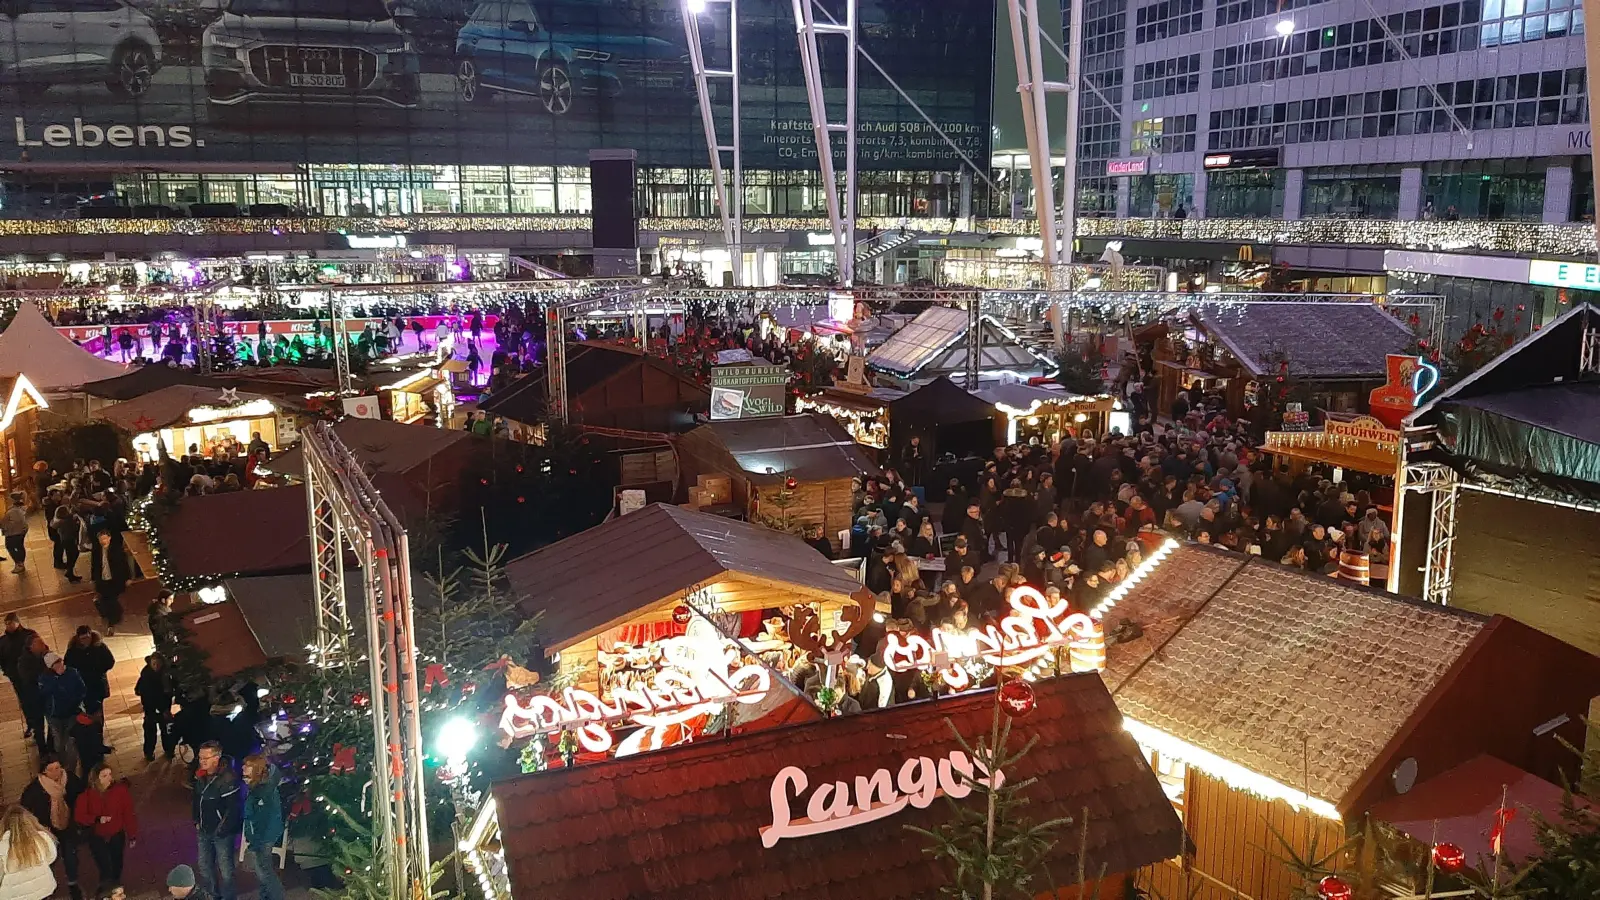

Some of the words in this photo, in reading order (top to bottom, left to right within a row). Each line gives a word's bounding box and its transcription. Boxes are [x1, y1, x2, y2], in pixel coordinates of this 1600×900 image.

[15, 117, 205, 147] Lebens.
[874, 122, 897, 133] Audi
[923, 122, 932, 132] in
[763, 133, 811, 144] innerorts
[861, 149, 870, 157] in
[873, 148, 902, 160] g/km:
[906, 148, 958, 159] kombiniert
[759, 402, 783, 413] WILD
[1336, 425, 1399, 442] GLÜHWEIN
[761, 749, 1005, 848] Langos
